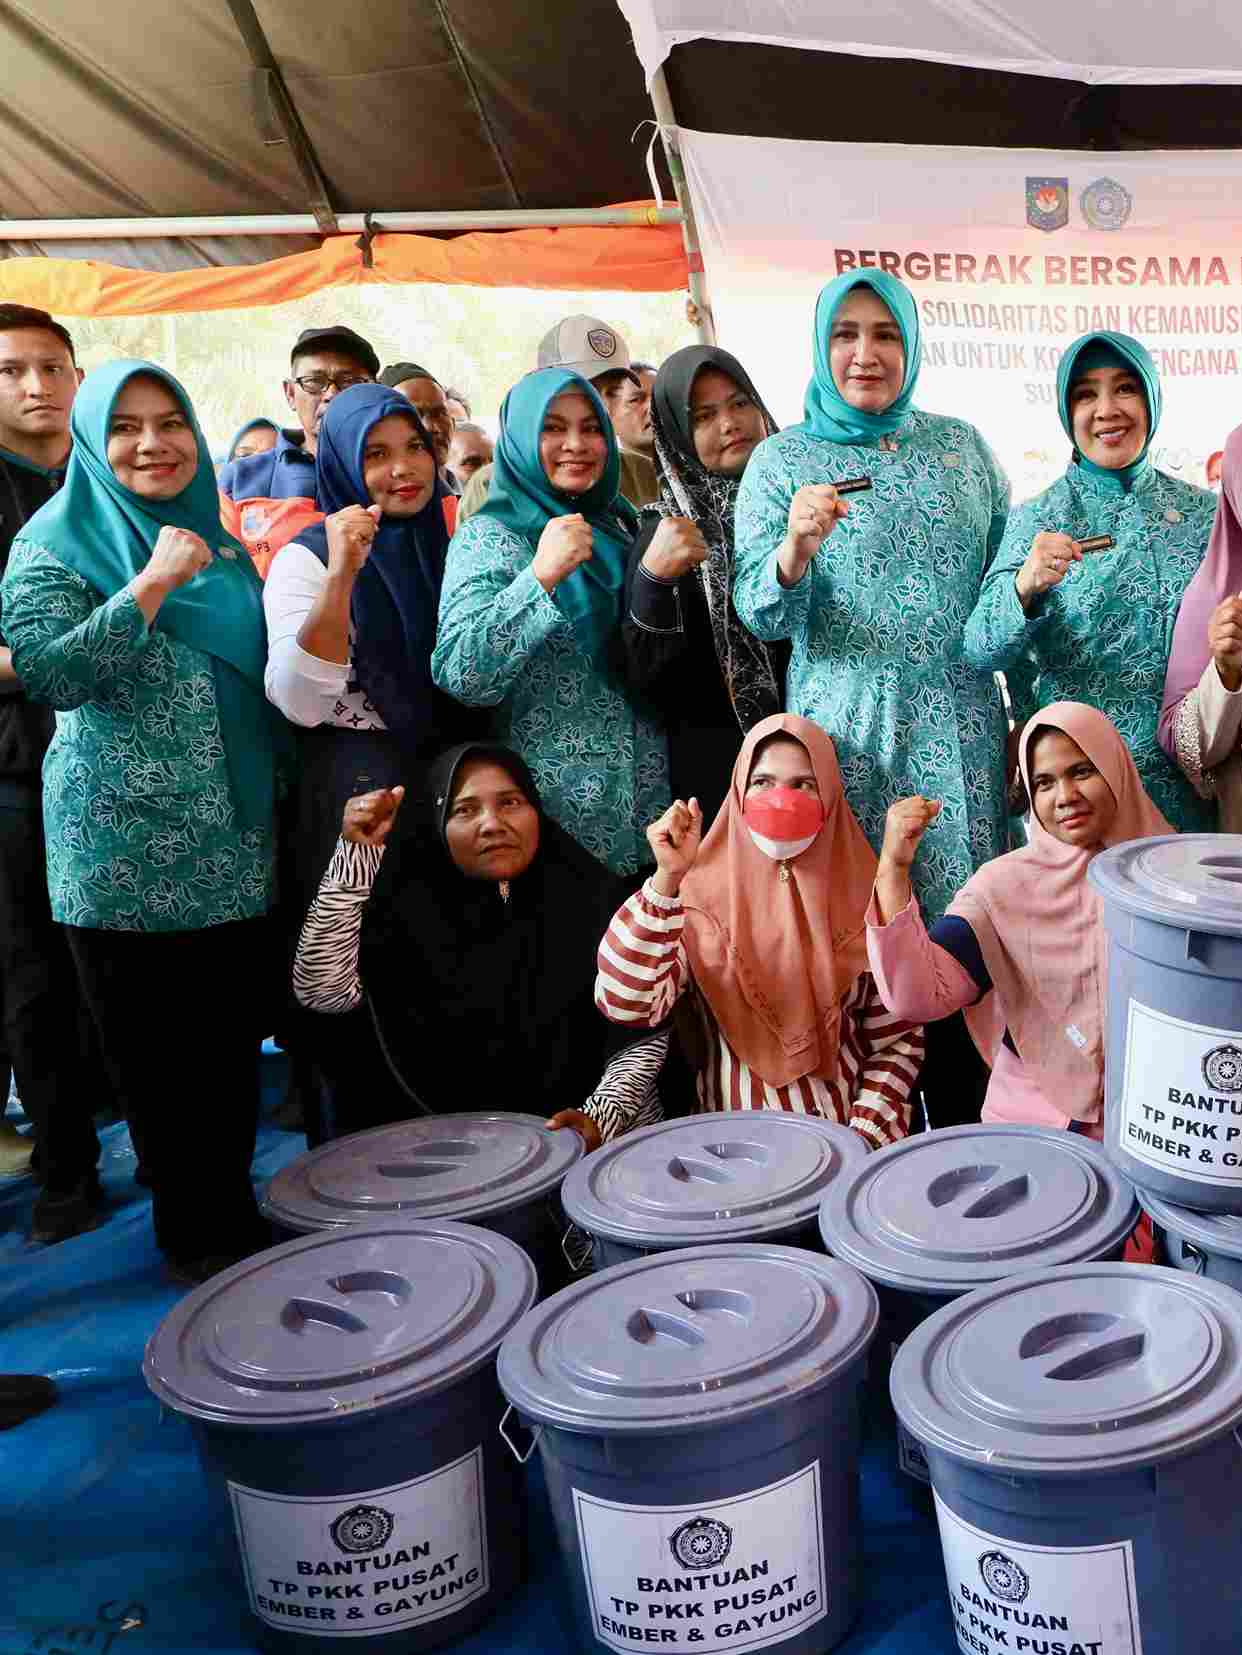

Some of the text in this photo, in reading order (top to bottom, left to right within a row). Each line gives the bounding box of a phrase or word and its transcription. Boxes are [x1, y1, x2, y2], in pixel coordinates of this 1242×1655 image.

[834, 249, 1032, 285] BERGERAK
[1044, 256, 1231, 286] BERSAMA
[922, 299, 1067, 334] SOLIDARITAS
[1075, 305, 1121, 333] DAN
[952, 342, 1028, 370] UNTUK
[1151, 348, 1238, 375] ENCANA
[1141, 1104, 1165, 1124] TP
[1172, 1116, 1218, 1140] PKK
[1128, 1123, 1191, 1159] EMBER
[1198, 1149, 1214, 1164] &
[269, 1553, 459, 1600] TP PKK PUSAT
[297, 1541, 430, 1576] BANTUAN
[637, 1559, 769, 1593] BANTUAN
[257, 1567, 479, 1621] EMBER & GAYUNG
[610, 1575, 798, 1619] TP PKK PUSAT
[960, 1583, 1069, 1631] BANTUAN
[600, 1590, 817, 1642] EMBER & GAYUNG
[969, 1613, 1009, 1646] PKK
[1016, 1635, 1103, 1655] PUSAT
